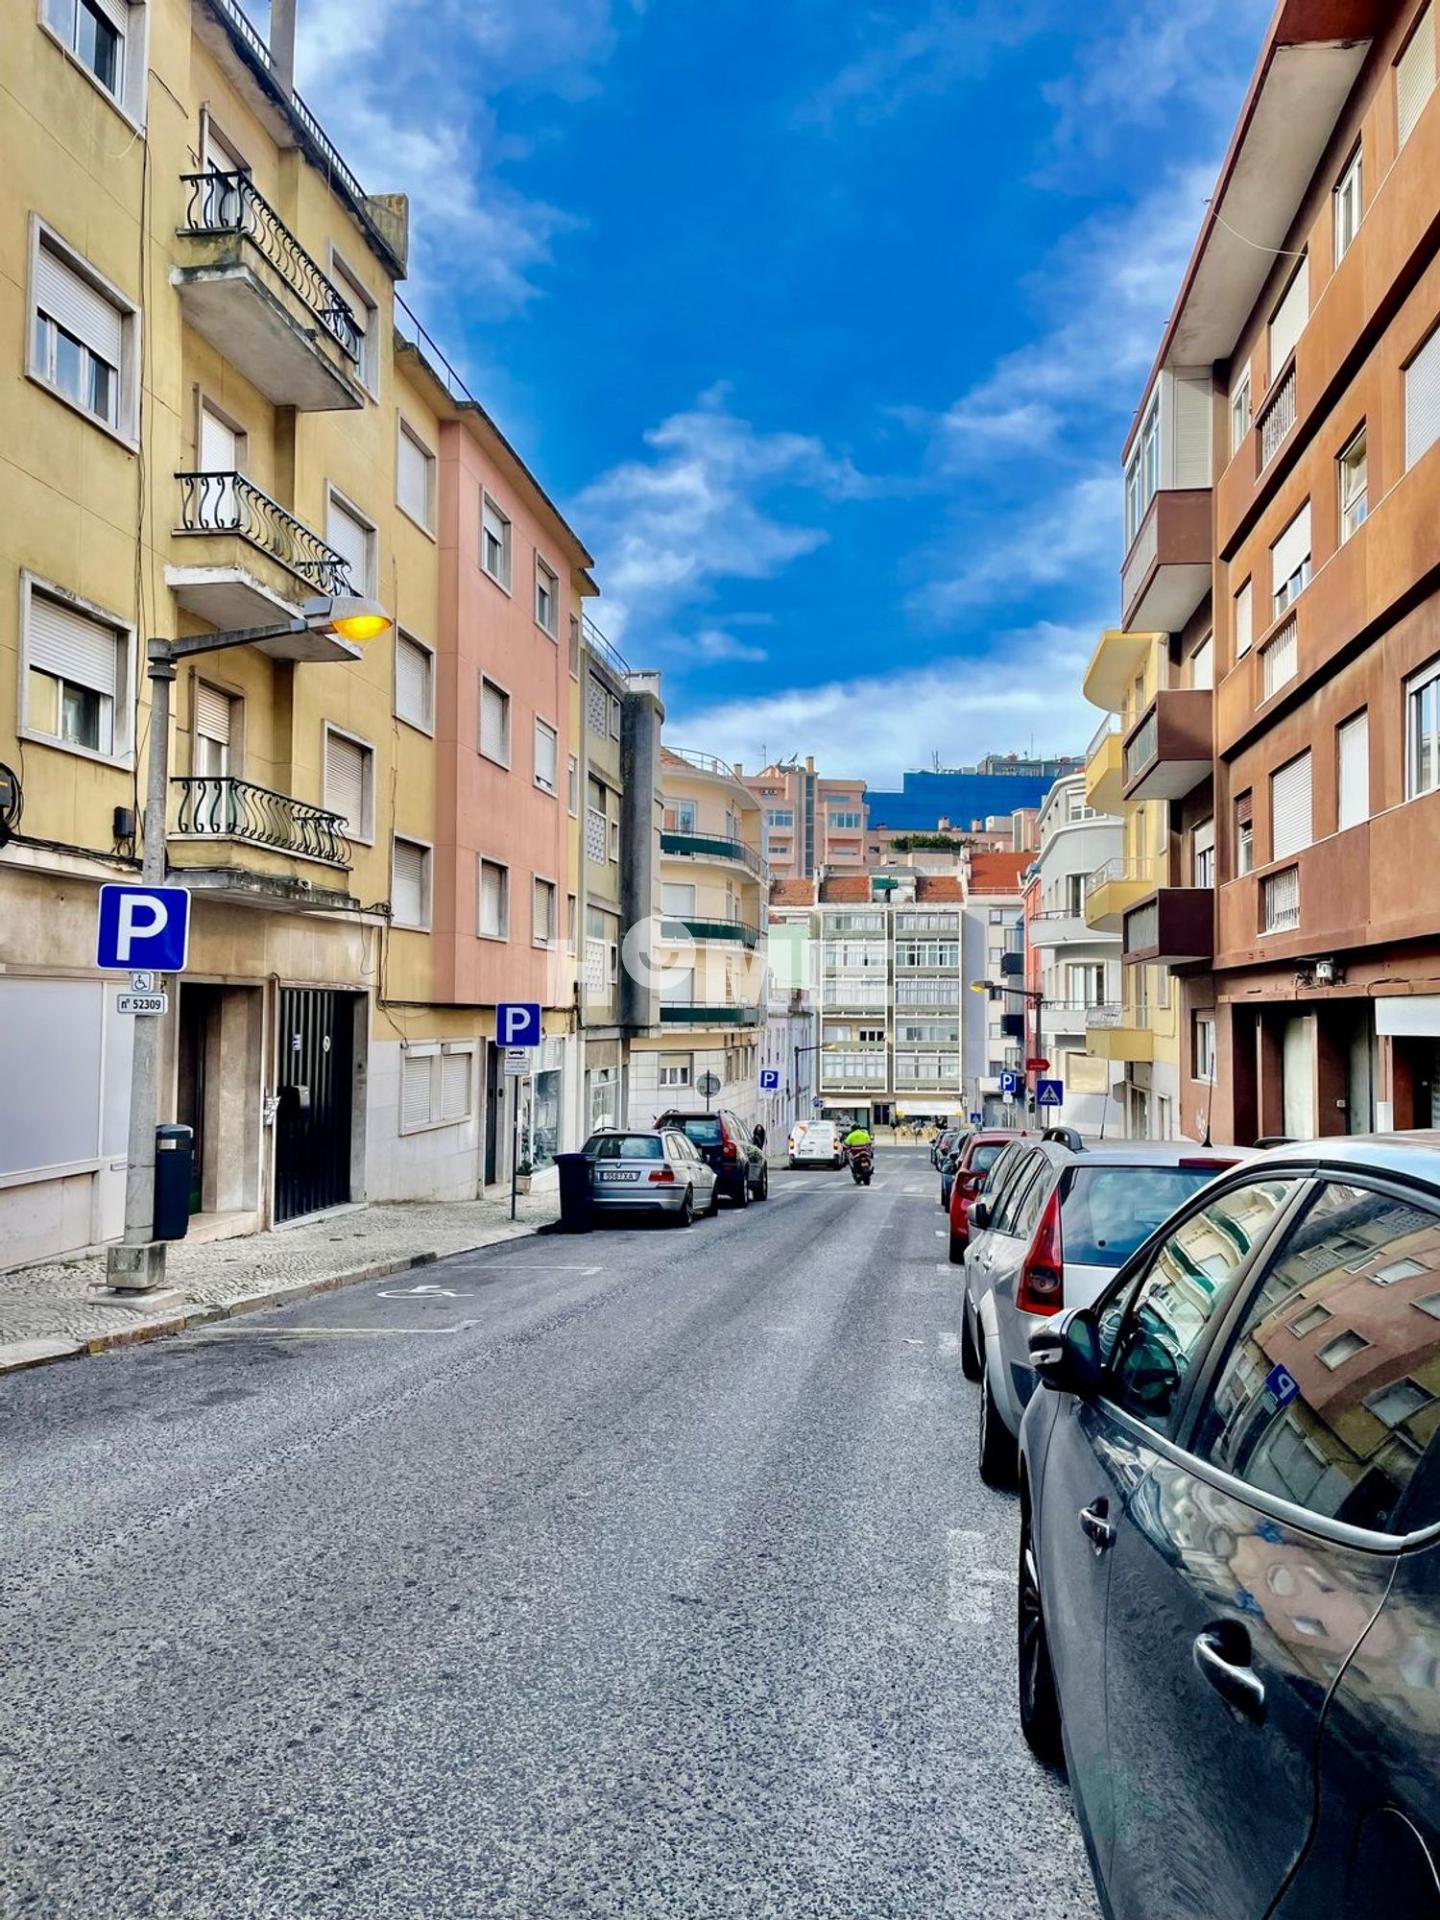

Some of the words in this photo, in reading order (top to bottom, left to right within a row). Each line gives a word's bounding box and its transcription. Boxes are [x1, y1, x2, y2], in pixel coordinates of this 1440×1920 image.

[116, 893, 168, 961] P
[133, 999, 161, 1010] 52309
[505, 1007, 531, 1043] P
[764, 1072, 775, 1086] P
[1003, 1074, 1012, 1089] P
